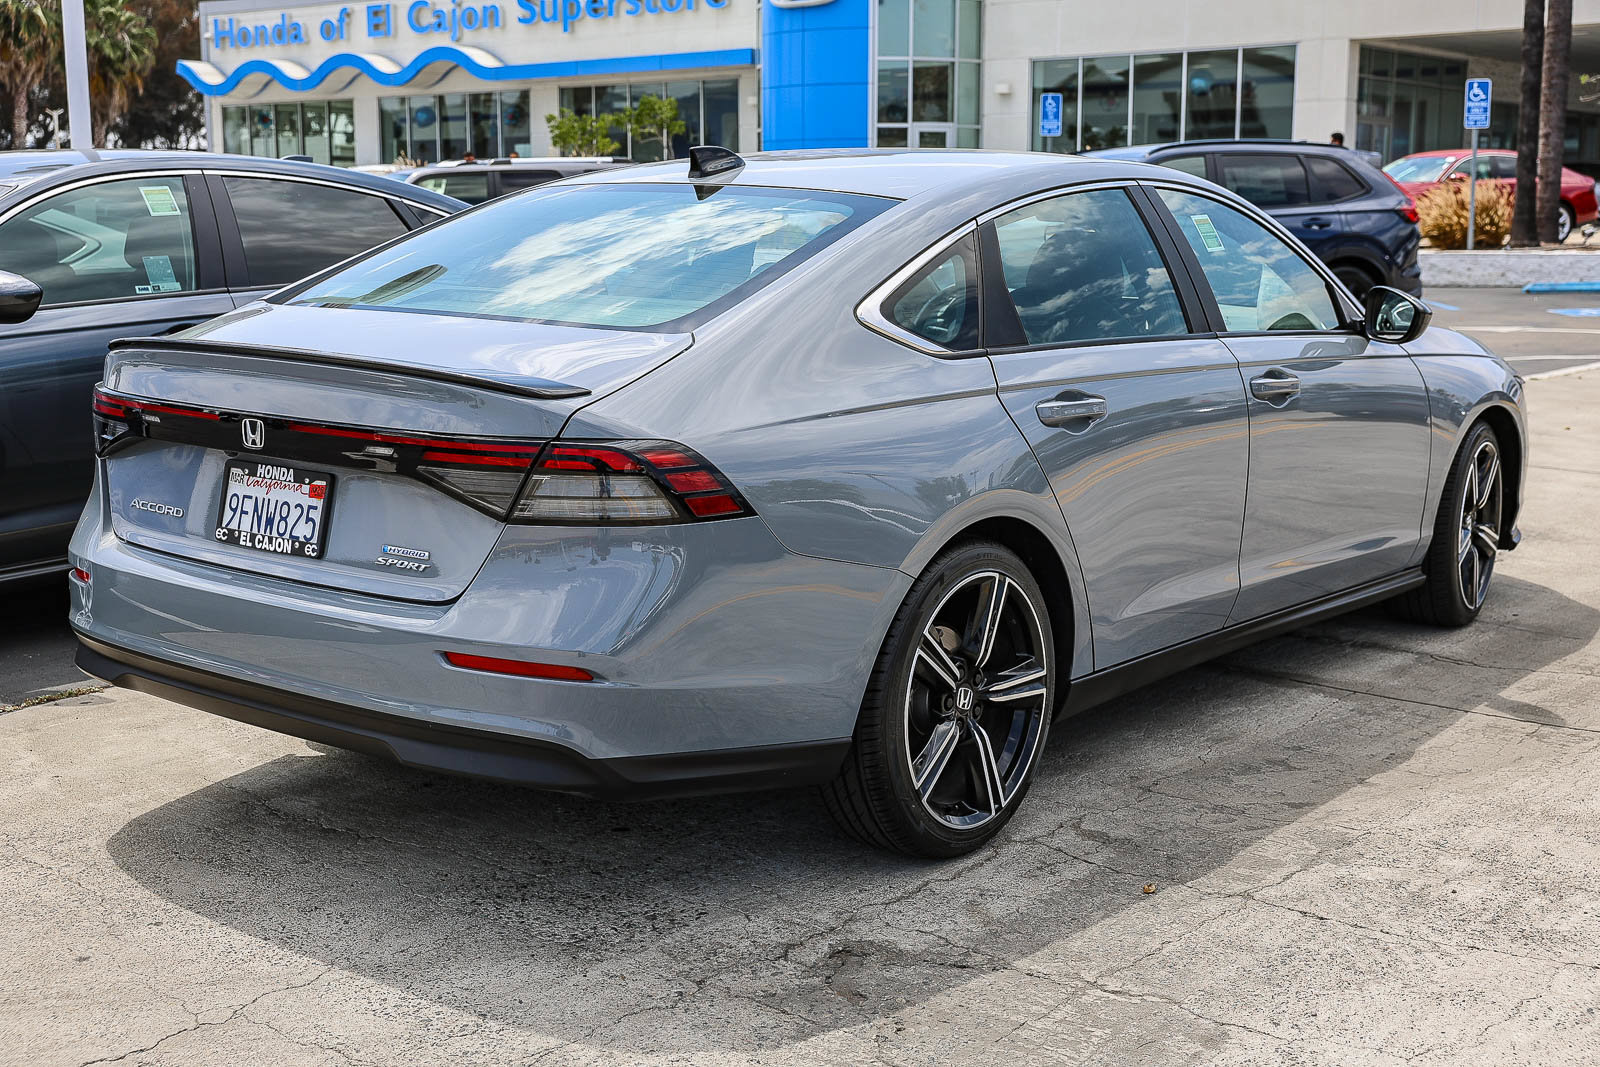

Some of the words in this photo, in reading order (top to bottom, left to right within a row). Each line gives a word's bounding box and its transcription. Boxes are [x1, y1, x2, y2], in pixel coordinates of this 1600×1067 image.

[213, 12, 305, 49] Honda
[320, 7, 349, 42] of
[366, 3, 392, 38] El
[407, 0, 501, 42] Cajon
[257, 464, 295, 482] HONDA
[129, 497, 184, 518] ACCORD
[224, 492, 319, 542] 9FNW825
[240, 531, 252, 547] EL
[254, 534, 292, 554] CAJON
[388, 546, 427, 558] HYBRID
[375, 557, 432, 572] SPORT
